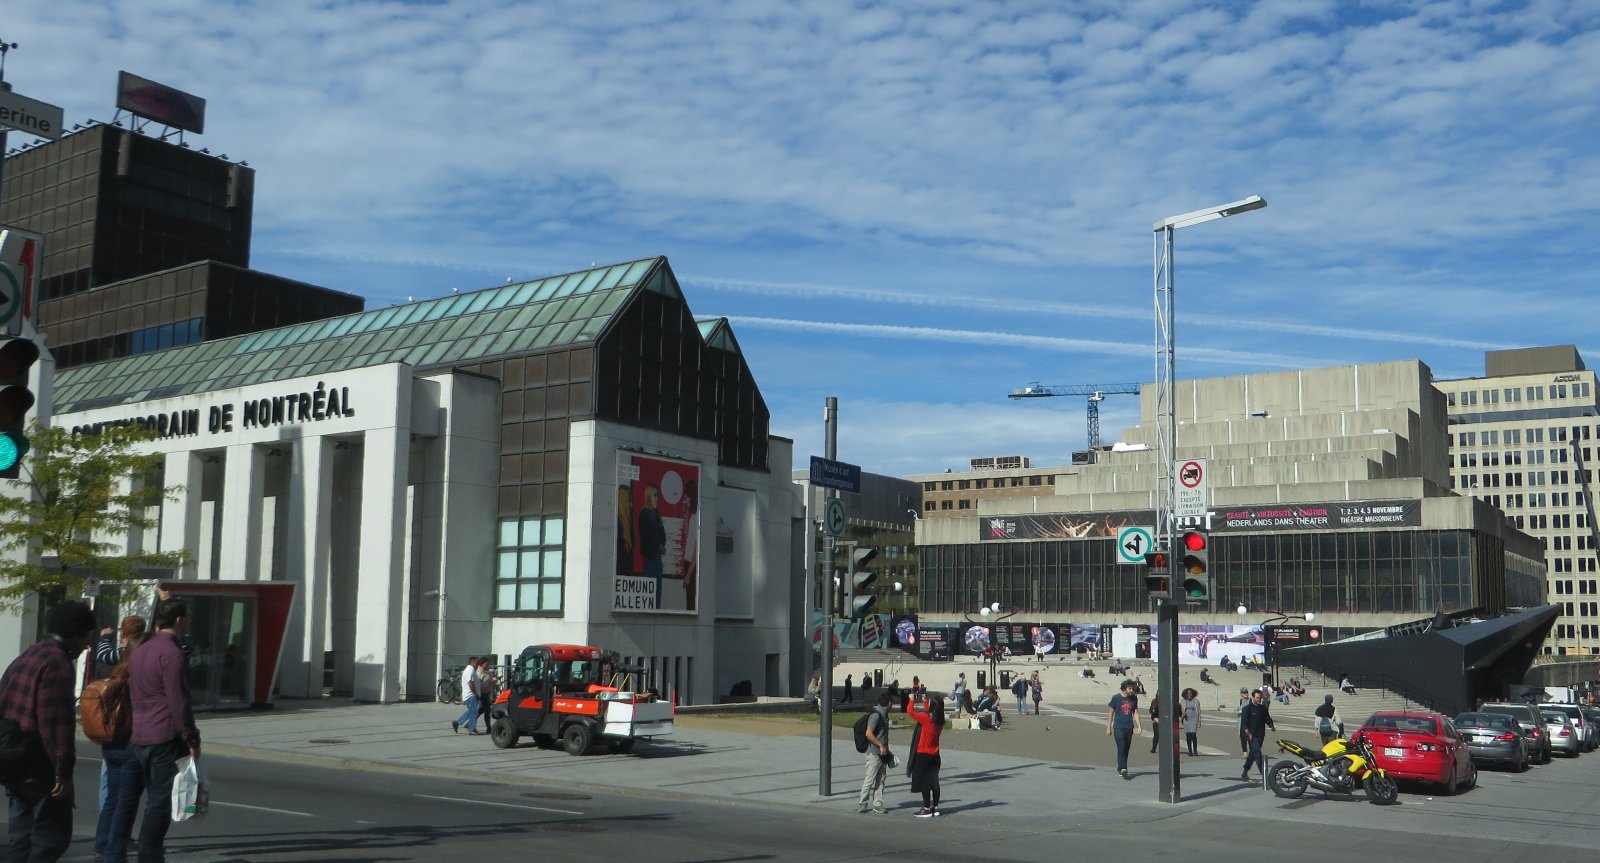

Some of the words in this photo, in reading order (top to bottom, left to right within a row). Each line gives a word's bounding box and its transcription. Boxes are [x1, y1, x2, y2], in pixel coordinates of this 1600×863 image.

[209, 404, 234, 434] DE
[243, 381, 355, 429] MONTRÉAL
[1372, 505, 1403, 514] NOVEMBRE
[1226, 518, 1272, 527] NEDERLANDS
[1274, 517, 1294, 526] DANS
[1295, 515, 1328, 525] THEATER
[1365, 514, 1404, 523] MAISONNEUVE
[615, 578, 655, 594] EDMUND
[614, 595, 655, 609] ALLEYN
